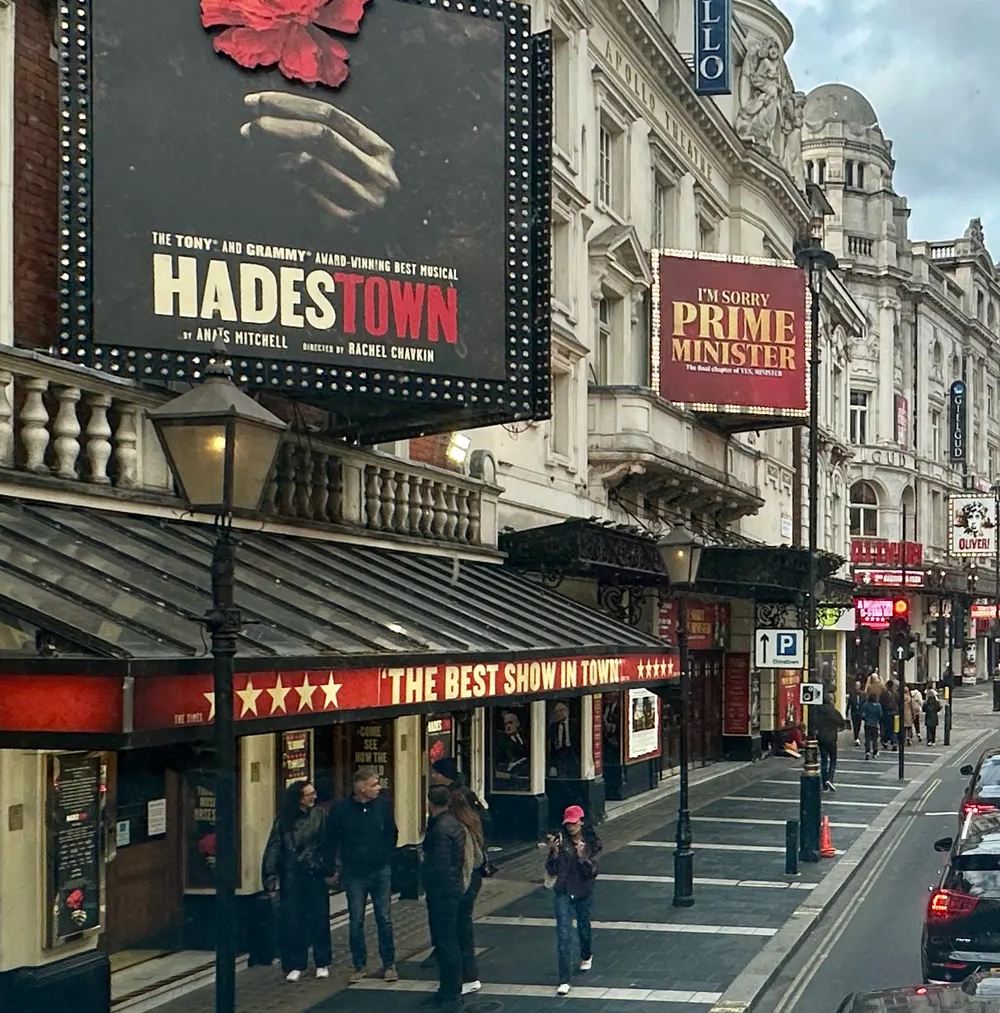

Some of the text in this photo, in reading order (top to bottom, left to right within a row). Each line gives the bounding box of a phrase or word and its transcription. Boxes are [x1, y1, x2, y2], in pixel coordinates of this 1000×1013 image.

[605, 40, 656, 113] APOLLO
[152, 231, 172, 246] THE
[222, 240, 242, 254] AND
[315, 252, 391, 272] AWARD-WINNING
[394, 261, 416, 275] BEST
[420, 264, 458, 281] MUSICAL
[153, 253, 458, 344] HADESTOWN
[697, 287, 771, 307] I'M SORRY
[671, 301, 797, 345] PRIME
[235, 331, 288, 349] MITCHELL
[302, 342, 333, 354] DIRECTED
[336, 346, 344, 354] BY
[348, 342, 388, 358] RACHEL
[391, 345, 435, 363] CHAVKIN
[671, 338, 797, 370] MINISTER
[698, 364, 711, 372] final
[712, 365, 732, 374] chapter
[733, 366, 740, 374] of
[755, 369, 783, 377] MINISTER
[958, 538, 990, 550] OLIVER!
[780, 635, 794, 654] P
[444, 663, 500, 700] BEST
[503, 661, 557, 694] SHOW
[560, 659, 578, 688] IN
[363, 739, 378, 750] SEE
[373, 751, 388, 763] THE
